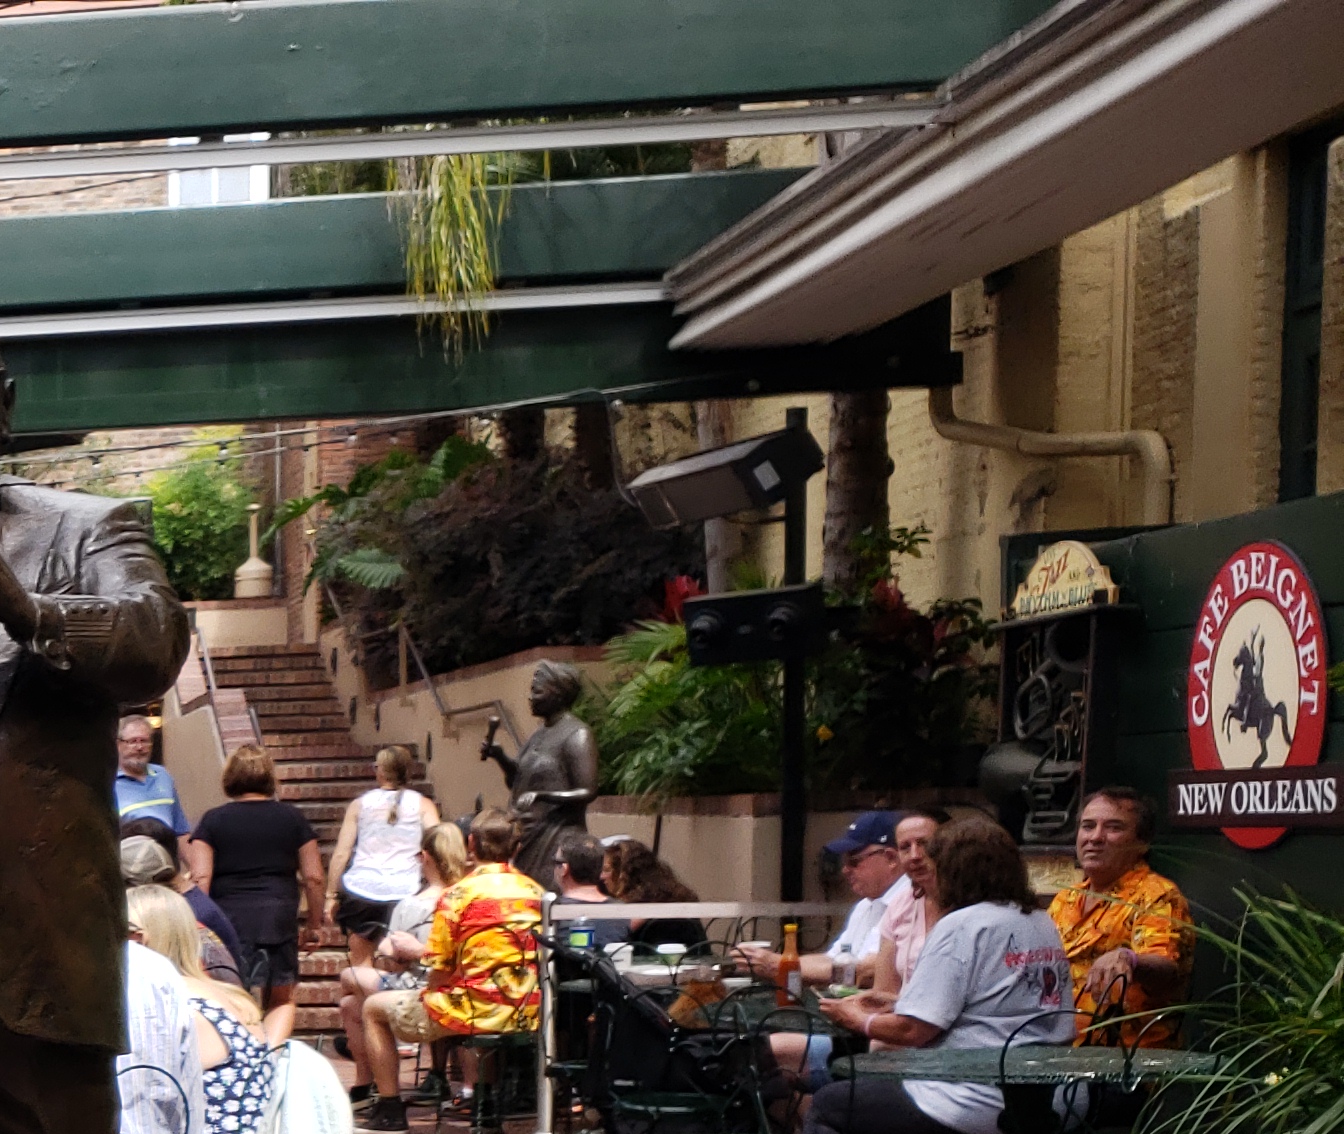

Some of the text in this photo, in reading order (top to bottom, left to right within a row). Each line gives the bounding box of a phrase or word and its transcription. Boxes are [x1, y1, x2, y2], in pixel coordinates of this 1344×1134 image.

[1191, 551, 1321, 727] CAFE BEIGNET
[1177, 777, 1338, 816] NEW ORLEANS
